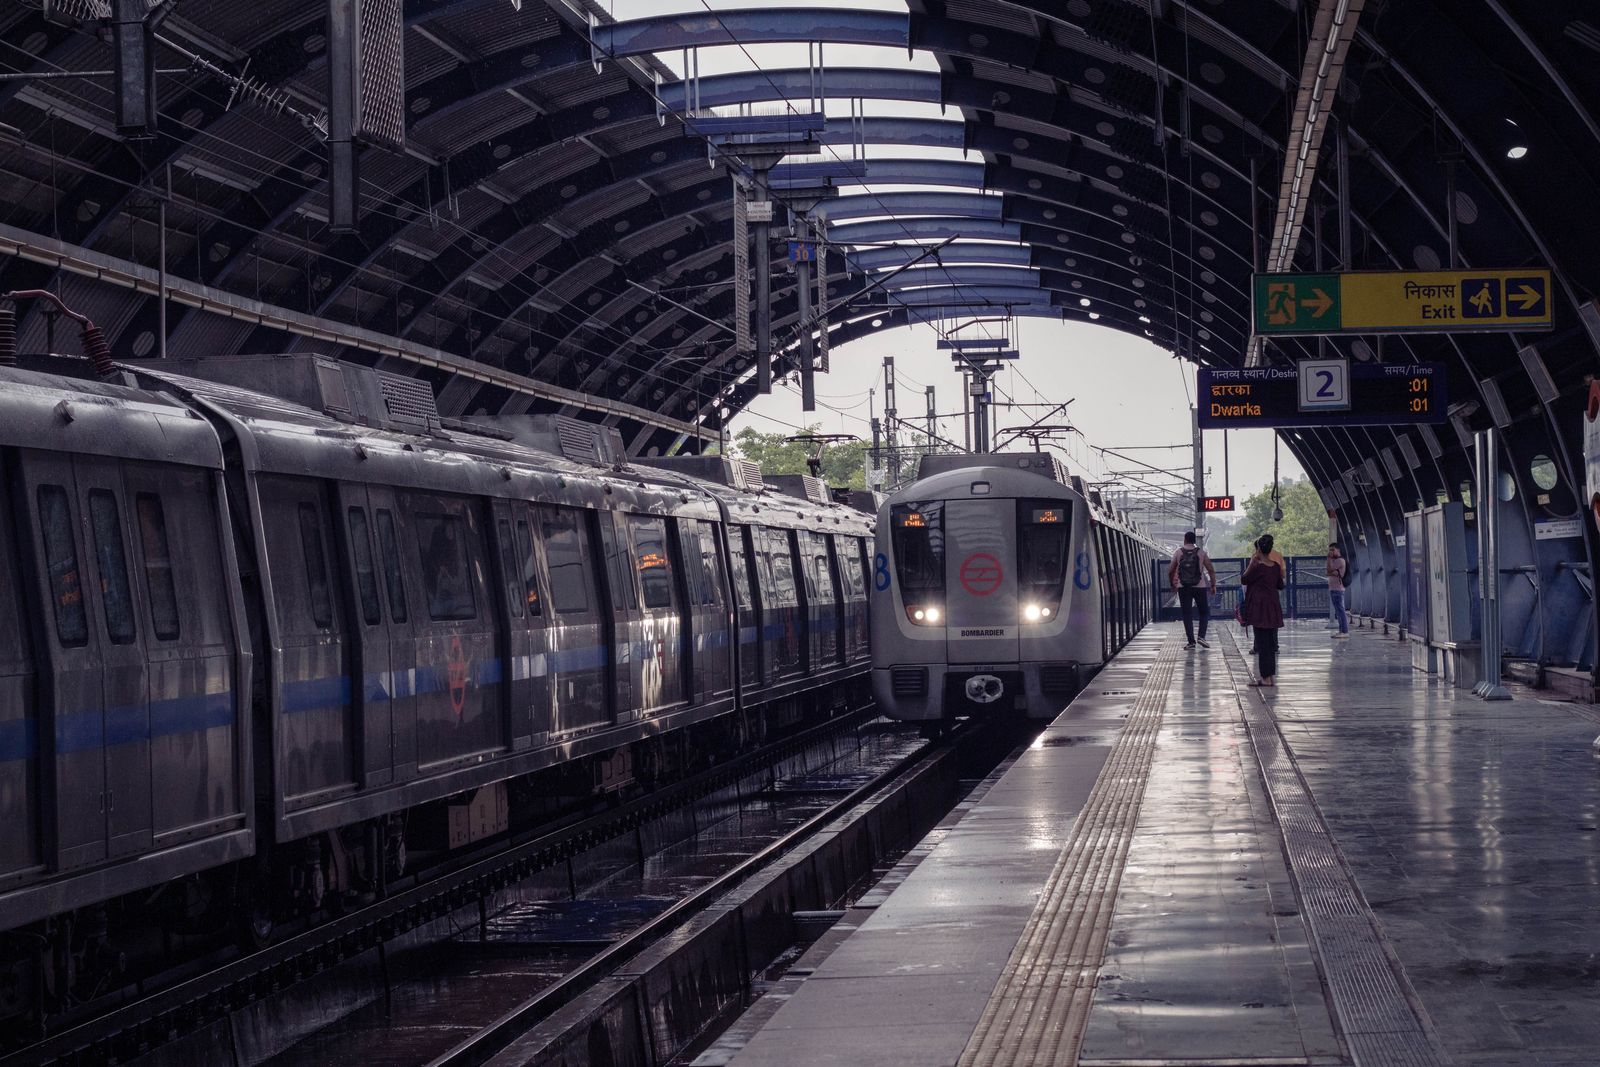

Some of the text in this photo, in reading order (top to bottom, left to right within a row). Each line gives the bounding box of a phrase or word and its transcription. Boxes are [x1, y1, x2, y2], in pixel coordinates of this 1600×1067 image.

[1403, 281, 1456, 299] निकास
[1422, 304, 1456, 319] Exit
[1211, 369, 1240, 379] गन्तव्य
[1384, 364, 1433, 375] समय/Time
[1211, 384, 1251, 396] द्वारका
[1316, 370, 1335, 397] 2
[1409, 378, 1428, 392] :01
[1211, 402, 1262, 416] Dwarka
[1409, 398, 1428, 411] :01
[1205, 498, 1231, 510] 10:10
[876, 552, 891, 592] 8
[1074, 551, 1092, 590] 8
[961, 629, 1005, 637] BOMBARDIER
